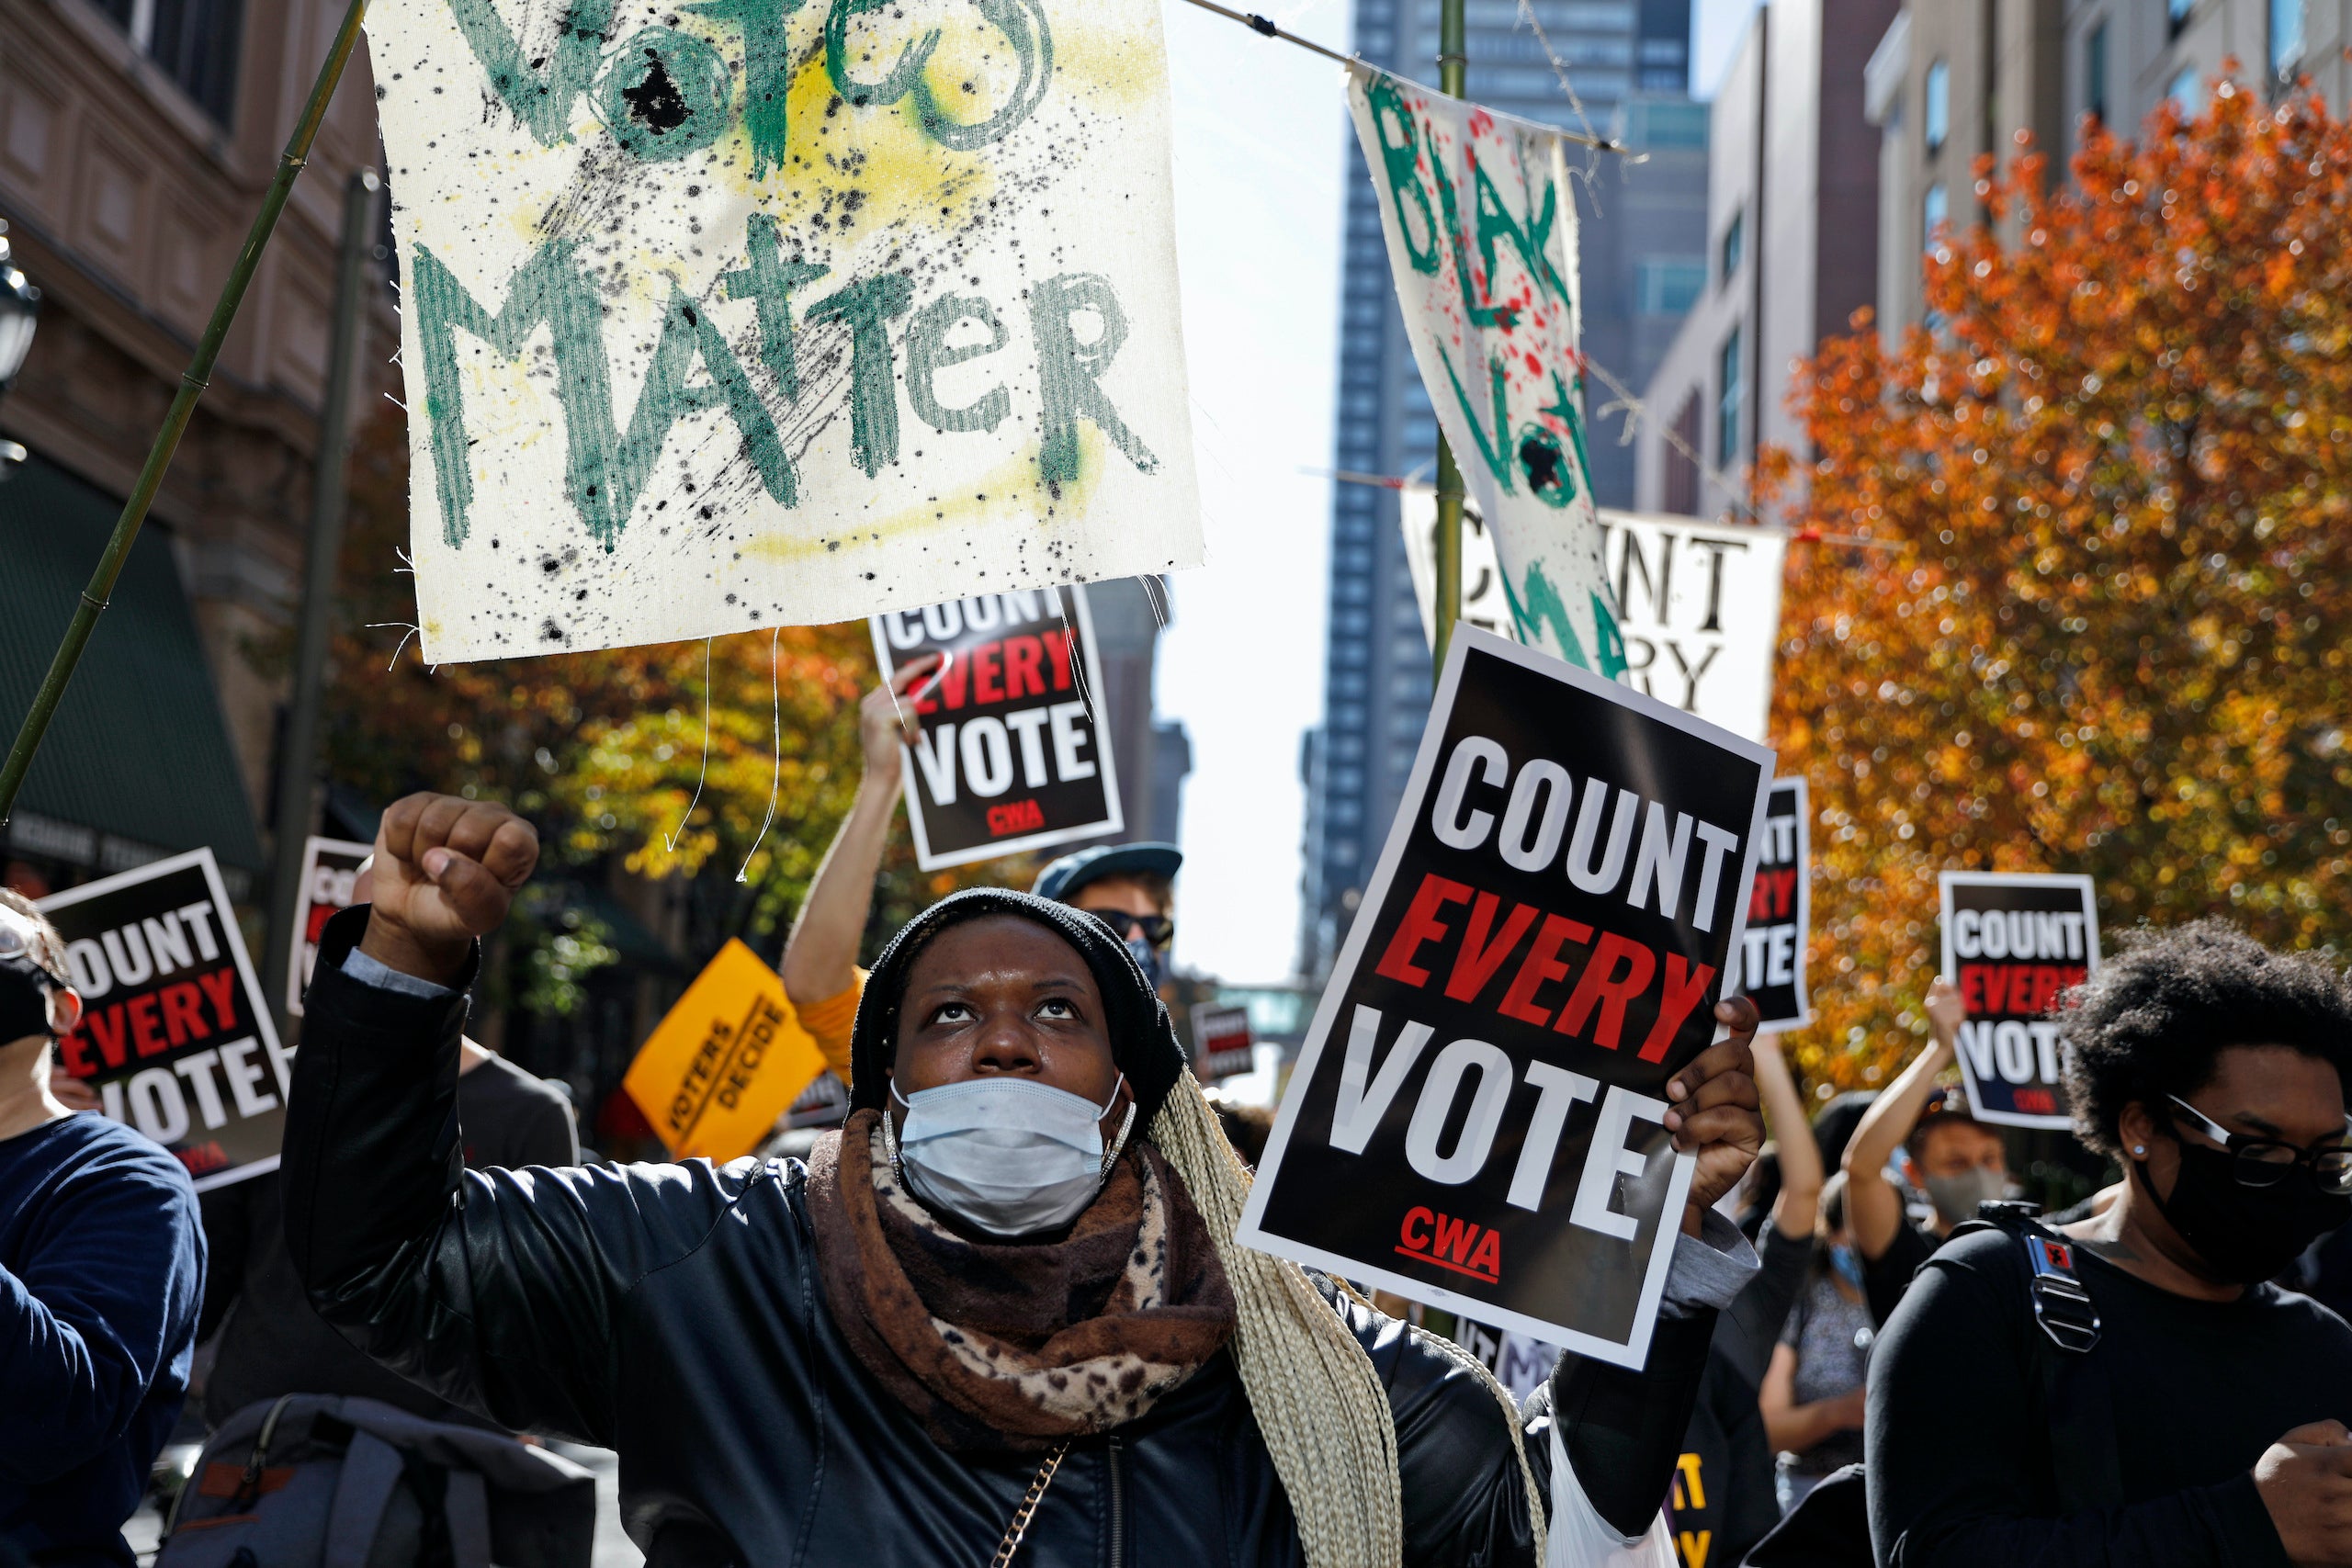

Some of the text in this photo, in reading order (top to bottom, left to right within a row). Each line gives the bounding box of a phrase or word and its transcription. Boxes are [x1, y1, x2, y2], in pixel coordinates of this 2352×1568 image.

[915, 700, 1097, 798] VOTE
[986, 798, 1045, 837] CWA
[1430, 734, 1739, 934] COUNT
[62, 899, 220, 999] OUNT
[1374, 872, 1716, 1066] EVERY
[1952, 908, 2085, 961] COUNT
[59, 966, 238, 1079] EVERY
[717, 1001, 786, 1111] DECIDE
[1958, 1019, 2078, 1084] VOT
[668, 1018, 733, 1133] VOTERS
[1328, 1003, 1669, 1242] VOTE
[1396, 1205, 1500, 1280] CWA
